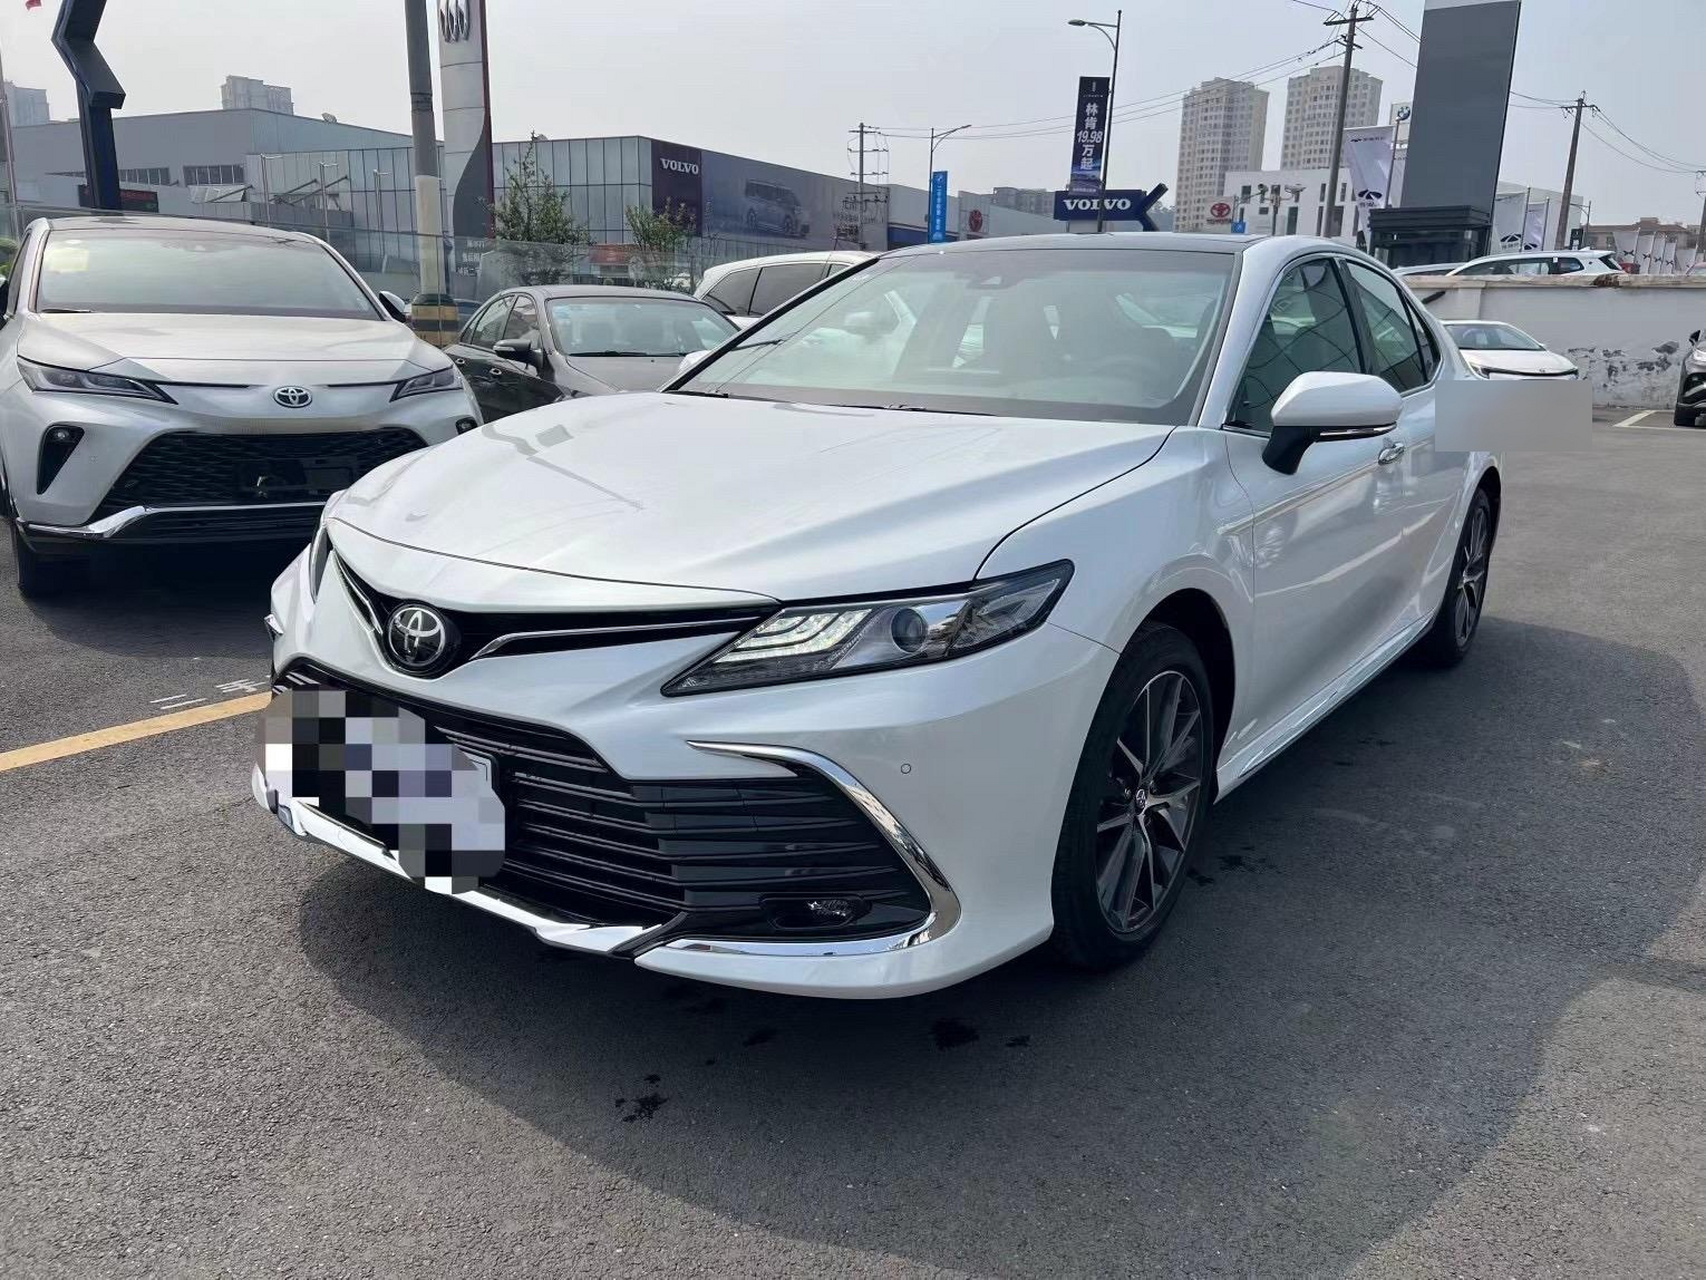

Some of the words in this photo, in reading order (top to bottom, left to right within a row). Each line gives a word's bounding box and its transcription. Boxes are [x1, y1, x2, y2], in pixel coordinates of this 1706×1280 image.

[1077, 102, 1103, 170] 林肯19.98万起
[660, 158, 699, 175] VOLVO
